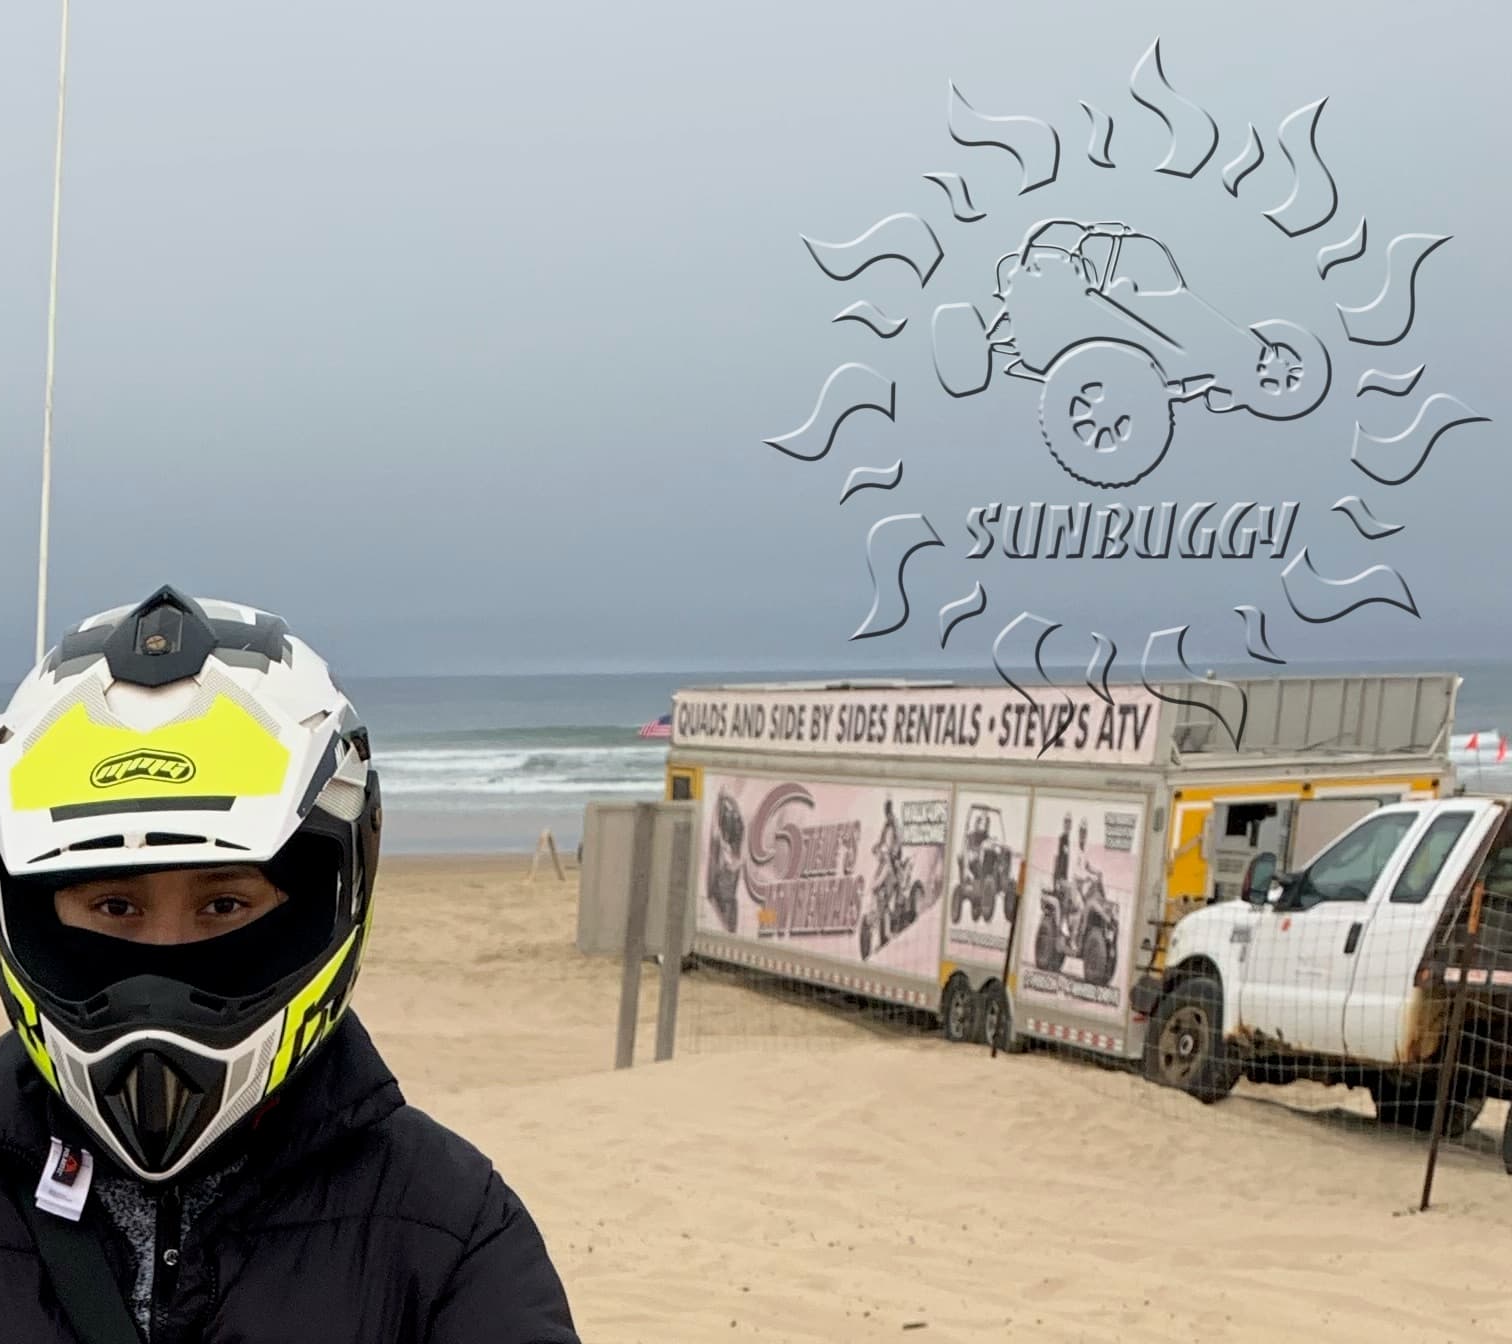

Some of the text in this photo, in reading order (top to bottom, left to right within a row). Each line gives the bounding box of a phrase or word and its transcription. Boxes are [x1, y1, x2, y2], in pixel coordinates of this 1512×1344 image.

[677, 702, 1153, 751] QUADS AND SIDE BY SIDES RENTALS STEVE'S ATV
